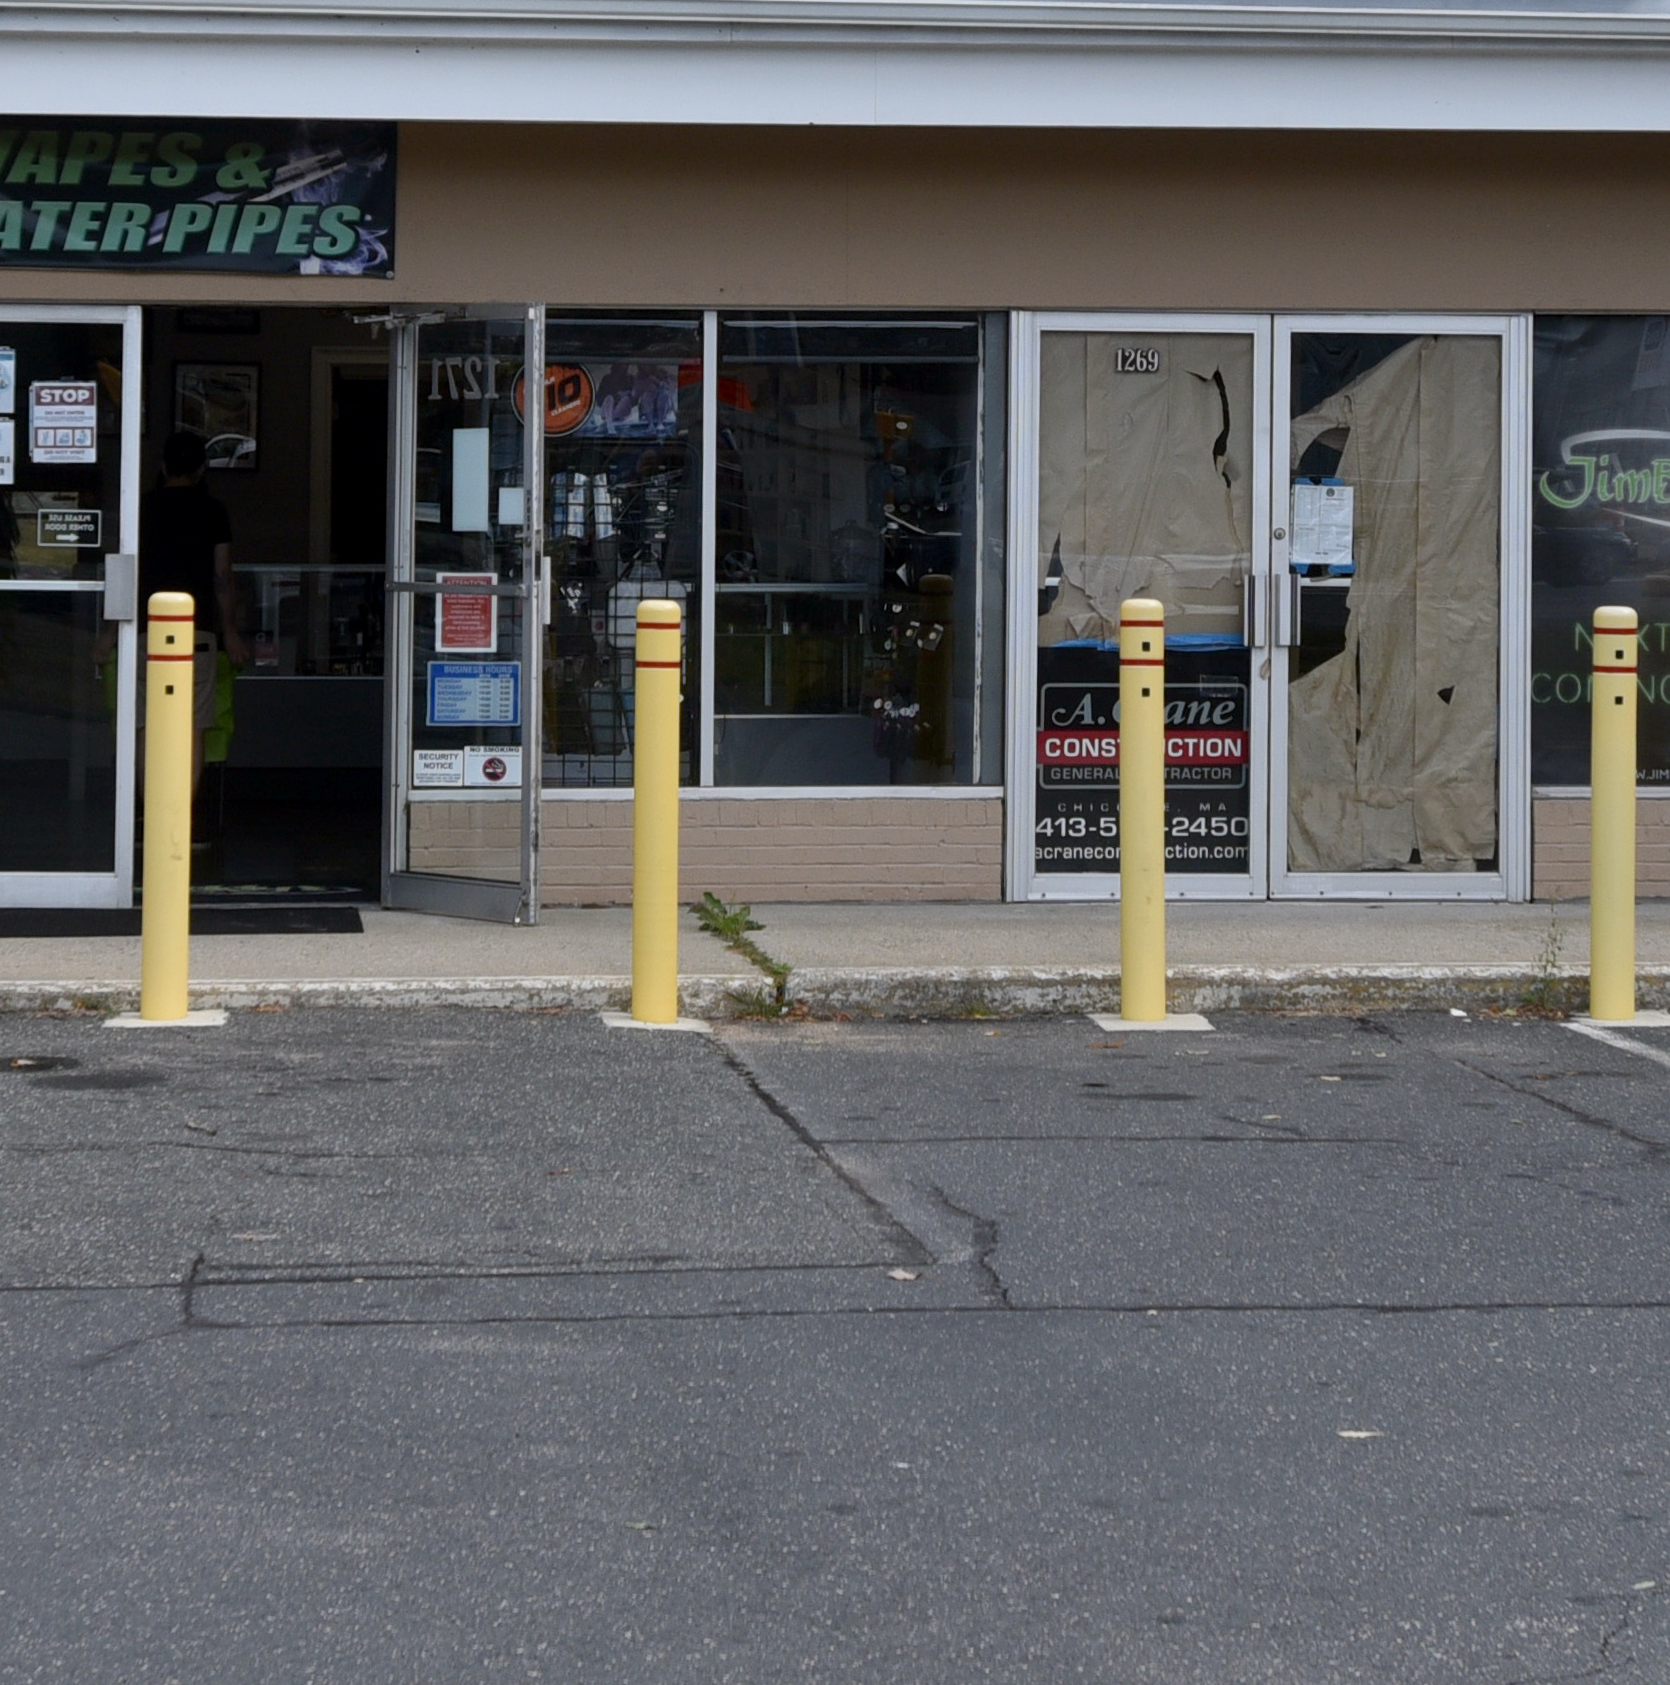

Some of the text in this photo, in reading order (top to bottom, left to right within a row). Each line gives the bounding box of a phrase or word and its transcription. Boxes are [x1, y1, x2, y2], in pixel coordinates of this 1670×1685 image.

[214, 141, 274, 190] &
[158, 200, 363, 258] PIPES
[1115, 348, 1160, 372] 1269
[40, 388, 90, 403] STOP
[1051, 692, 1236, 726] A. ane
[419, 753, 459, 761] SECURITY
[1045, 738, 1242, 757] CONSCTION
[1051, 767, 1232, 780] GENERAL TRACTOR
[1199, 803, 1227, 812] MA
[1035, 817, 1249, 837] 413-5-2450
[1035, 842, 1249, 859] acranecoction.com
